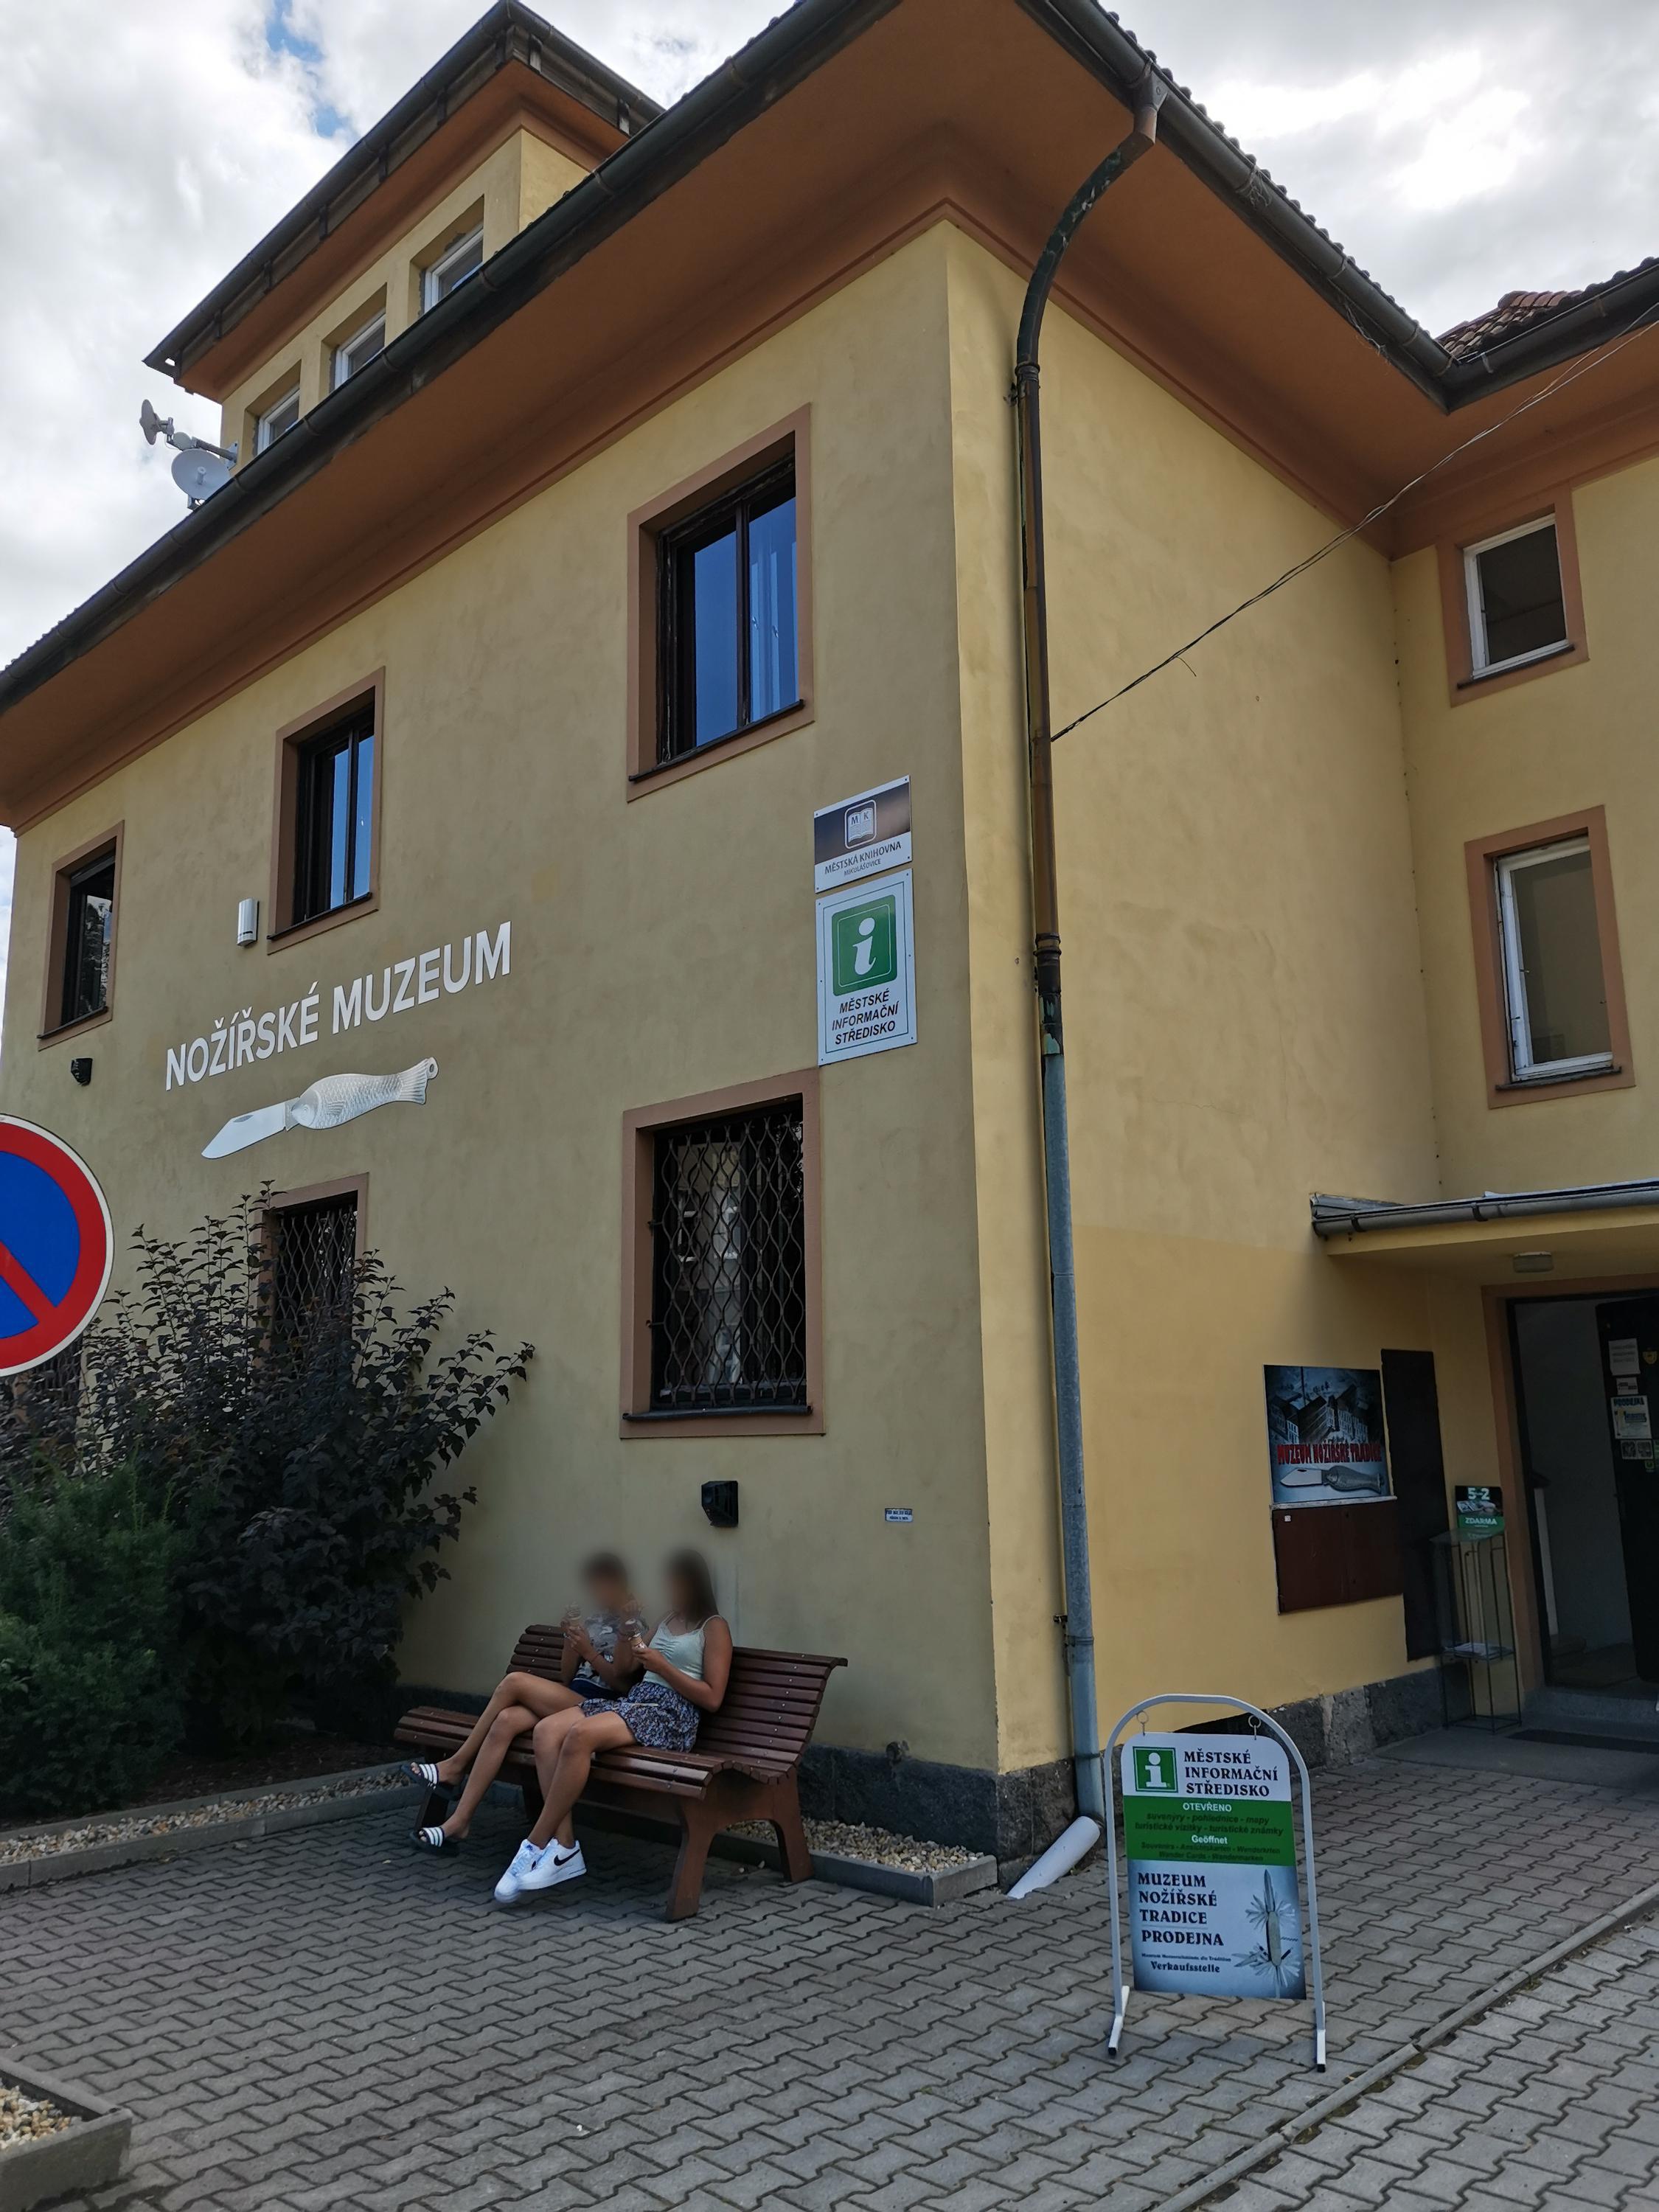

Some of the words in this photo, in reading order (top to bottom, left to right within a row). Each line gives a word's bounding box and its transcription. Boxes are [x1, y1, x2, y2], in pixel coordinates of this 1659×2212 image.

[824, 855, 858, 874] MĚSTSKÁ
[860, 841, 901, 864] KNIHOVNA
[844, 858, 881, 876] MIKULÁŠOVICE
[165, 980, 320, 1091] NOŽÍŘSKÉ
[332, 920, 512, 1034] MUZEUM
[839, 988, 889, 1014] MĚSTSKÉ
[832, 1001, 900, 1031] INFORMAČNÍ
[835, 1020, 896, 1045] STŘEDISKO
[1465, 1517, 1498, 1526] ZDARMA
[1184, 1748, 1251, 1764] MĚSTSKÉ
[1185, 1766, 1279, 1781] INFORMAČNÍ
[1186, 1781, 1270, 1797] STŘEDISKO
[1183, 1801, 1232, 1812] OTEVŘENO
[1192, 1834, 1228, 1845] Geöffnet
[1138, 1872, 1206, 1888] MUZEUM
[1138, 1888, 1217, 1907] NOŽÍŘSKÉ
[1140, 1909, 1207, 1924] TRADICE
[1141, 1930, 1224, 1947] PRODEJNA
[1150, 1961, 1220, 1973] Verkaufsstelle
